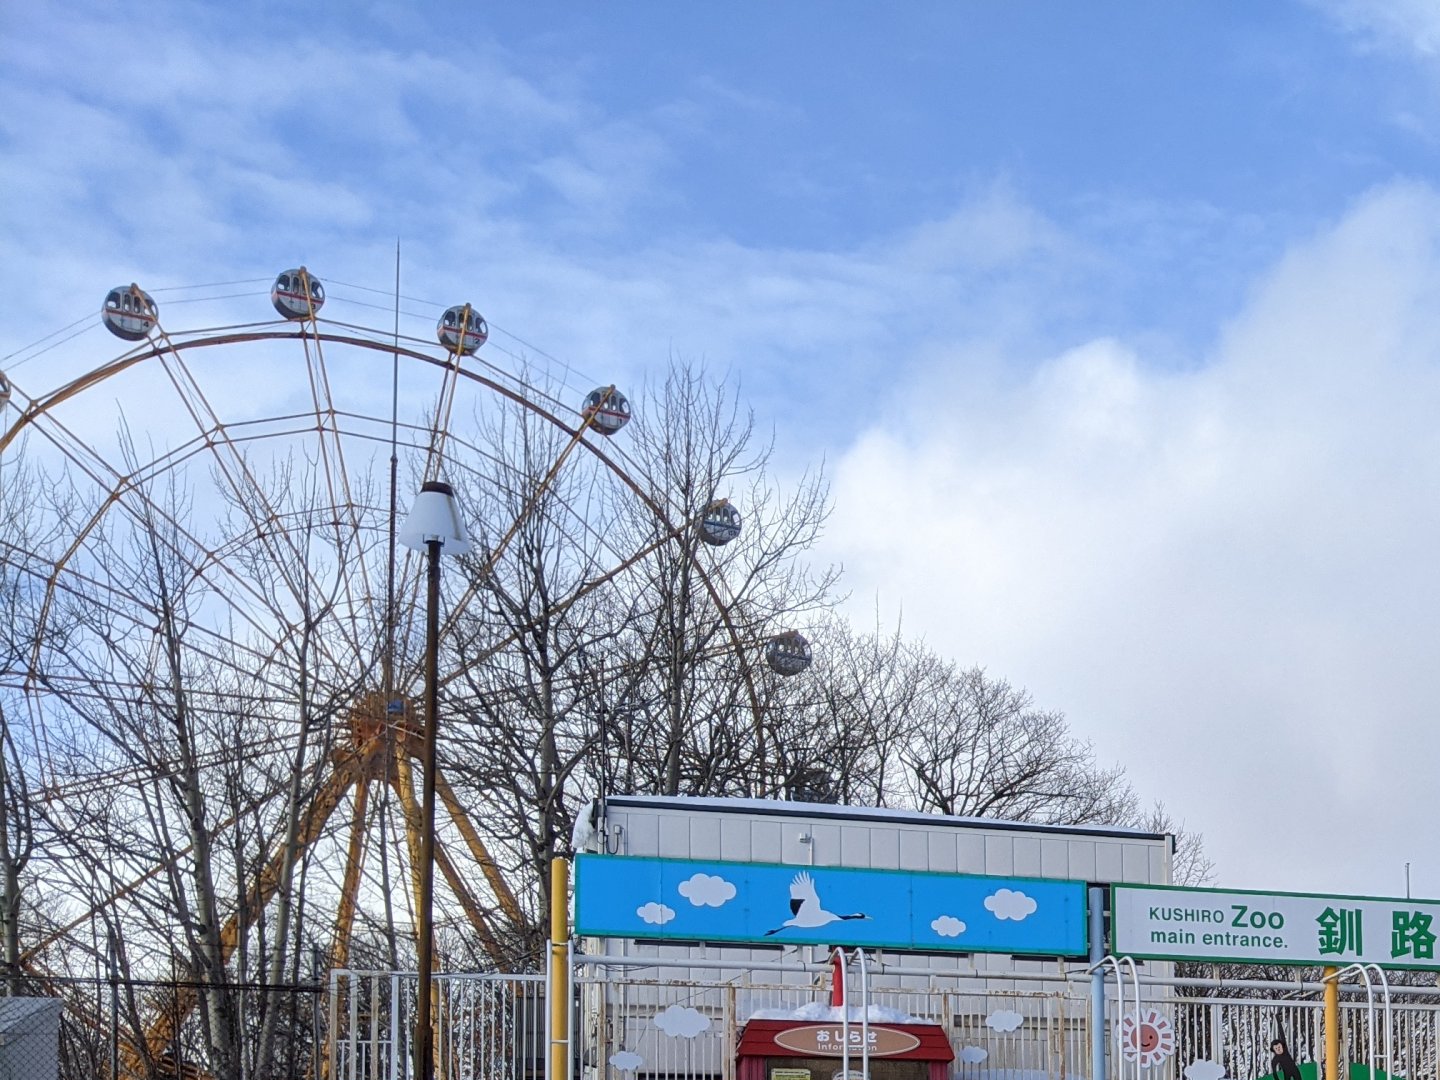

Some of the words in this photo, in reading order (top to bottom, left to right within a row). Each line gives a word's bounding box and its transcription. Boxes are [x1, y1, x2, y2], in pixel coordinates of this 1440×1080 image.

[1149, 907, 1225, 923] KUSHIRO
[1231, 905, 1285, 929] Zoo
[1151, 929, 1195, 944] main
[1202, 932, 1288, 949] entrance.
[816, 1030, 878, 1043] おしらせ
